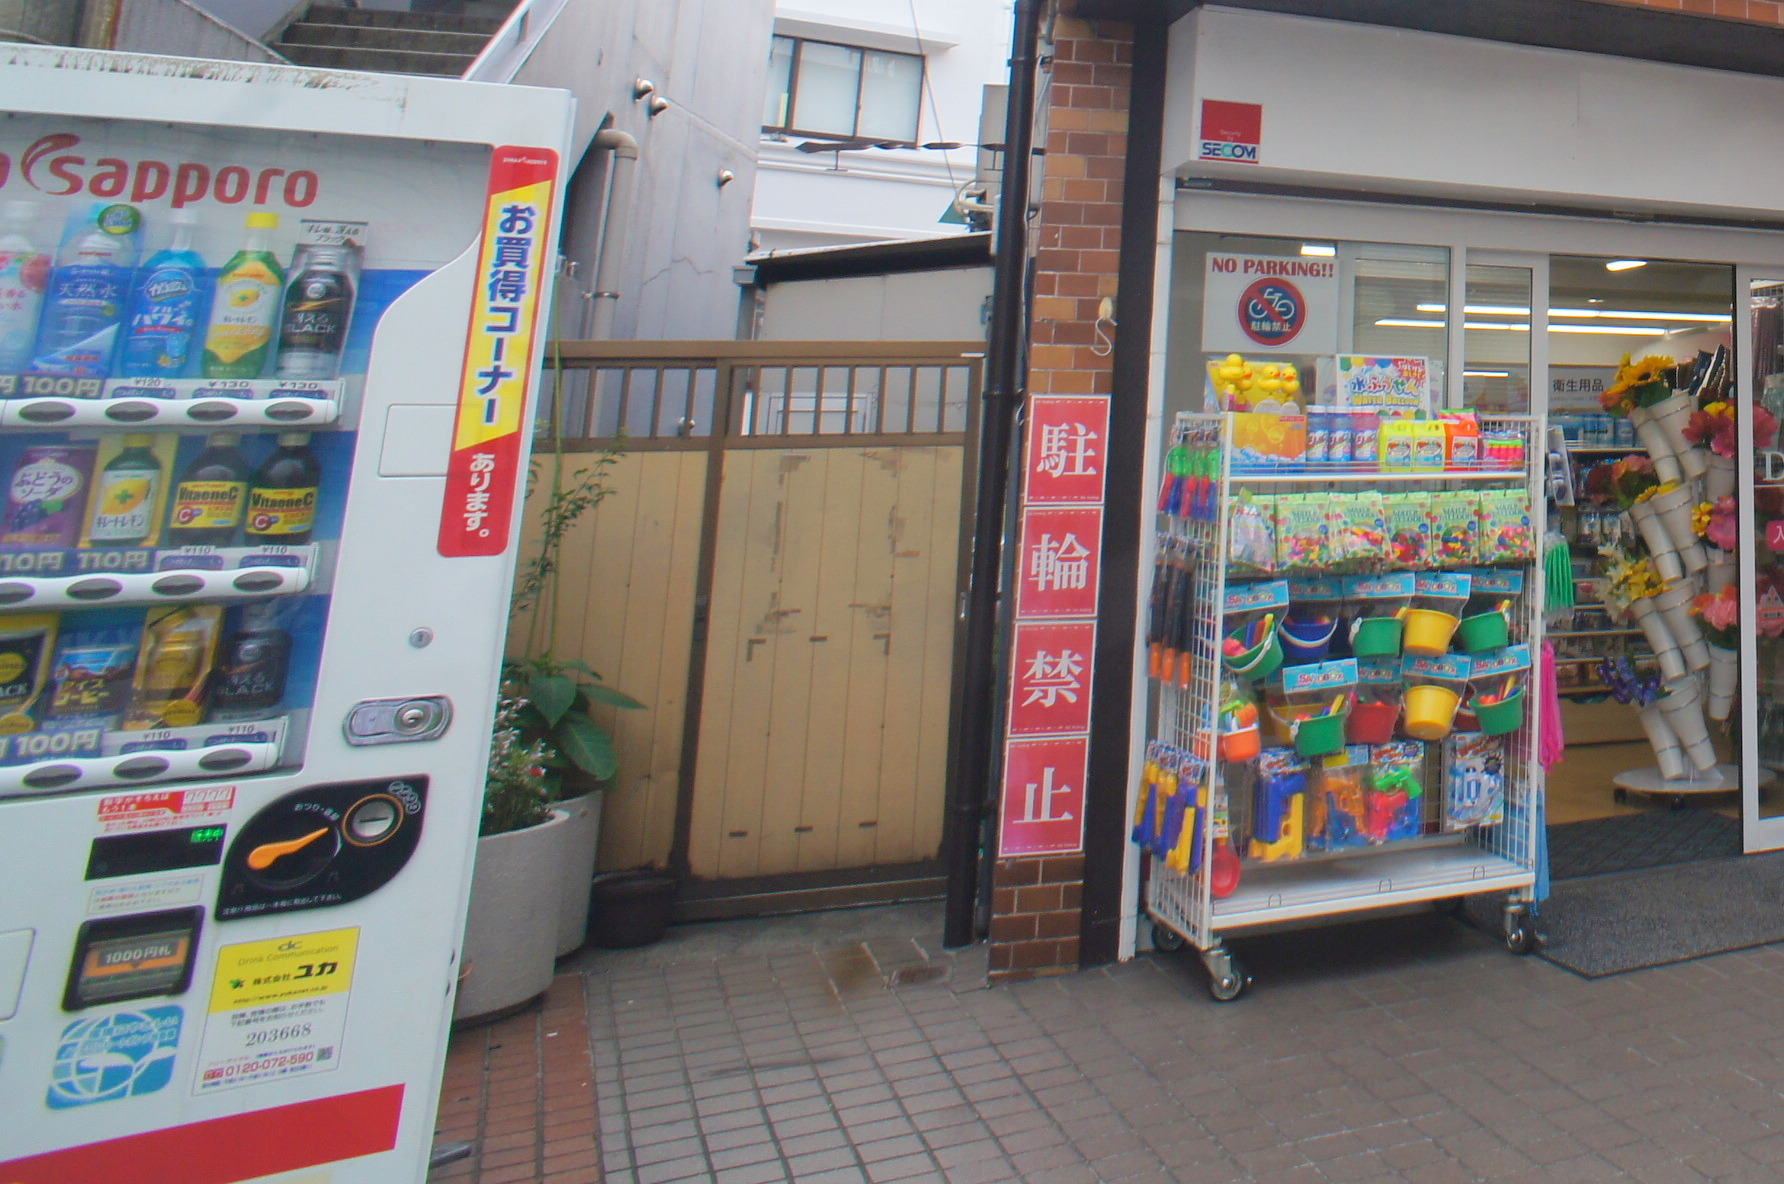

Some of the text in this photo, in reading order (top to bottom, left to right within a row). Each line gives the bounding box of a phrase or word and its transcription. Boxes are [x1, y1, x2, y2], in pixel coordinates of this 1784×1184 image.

[1202, 142, 1256, 160] SECOM
[1212, 257, 1334, 278] NO PARKING!!
[58, 283, 118, 299] 天然水
[476, 202, 537, 424] お買得コーナー
[1251, 320, 1292, 333] 駐輪禁止
[22, 377, 101, 397] 100円
[1552, 378, 1605, 392] 衛生用品
[462, 451, 497, 539] あります。
[77, 551, 148, 568] 110円
[1013, 422, 1098, 826] 駐輪禁止
[17, 729, 99, 756] 100円
[105, 944, 173, 964] 1000円札
[238, 956, 264, 966] Drink
[245, 1023, 312, 1047] 203668
